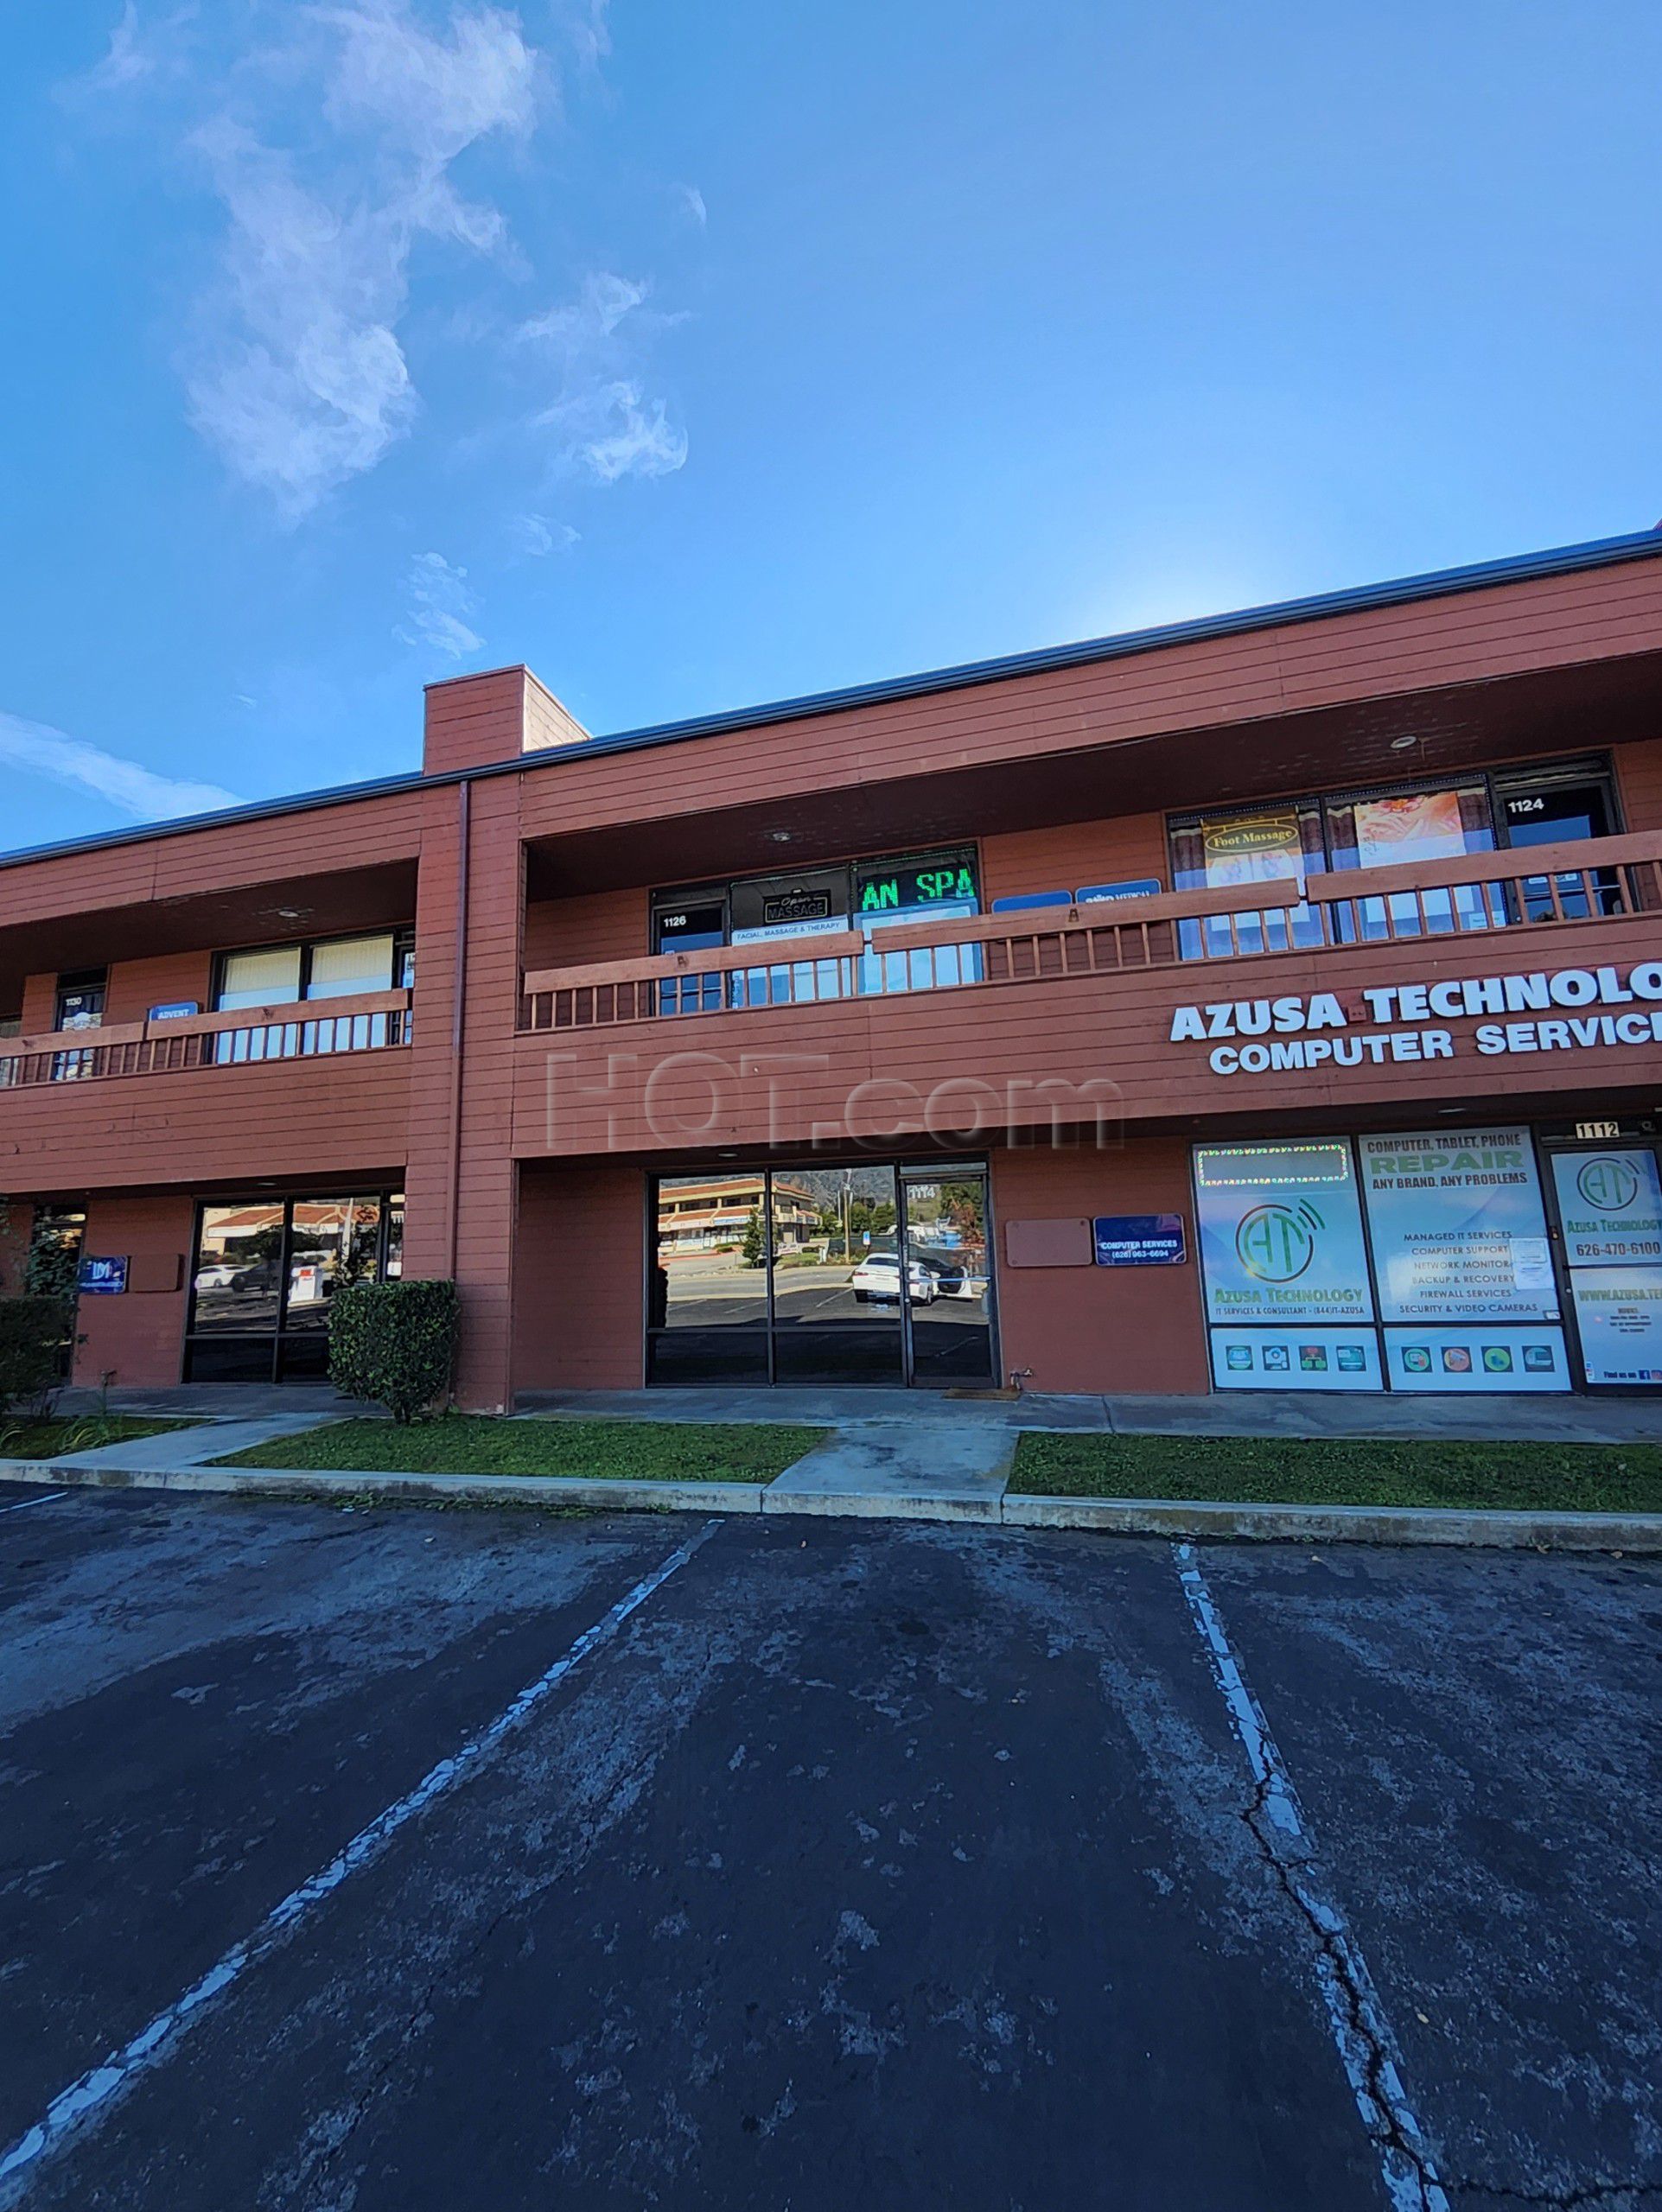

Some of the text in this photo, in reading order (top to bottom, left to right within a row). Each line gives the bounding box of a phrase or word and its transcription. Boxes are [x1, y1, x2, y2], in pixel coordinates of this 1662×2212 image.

[1508, 798, 1544, 813] 1124
[1213, 830, 1293, 847] Foot Massage
[916, 868, 975, 903] SPA
[781, 896, 812, 907] Open
[768, 903, 824, 919] MASSAGE
[664, 916, 686, 927] 1126
[765, 927, 799, 937] MASSAGE
[807, 922, 840, 931] THERAPY
[158, 1008, 189, 1020] ADVENT
[1169, 993, 1347, 1042] AZUSA
[1209, 1029, 1454, 1075] COMPUTER
[1579, 1123, 1616, 1137] 1112
[1367, 1134, 1521, 1154] COMPUTER, TABLET, PHONE
[1370, 1150, 1525, 1174] REPAIR
[1372, 1178, 1394, 1190] ANY
[1441, 1175, 1462, 1186] ANY
[1465, 1172, 1528, 1185] PROBLEMS
[909, 1186, 935, 1198] 1114
[1567, 1219, 1598, 1233] AZUSA
[1404, 1232, 1455, 1242] MANAGED
[1468, 1230, 1512, 1240] SERVICES
[1101, 1240, 1178, 1249] COMPUTER SERVICES
[1411, 1245, 1509, 1255] COMPUTER SUPPORT
[1576, 1242, 1660, 1256] 626-470-6100
[1414, 1261, 1460, 1270] NETWORK
[1412, 1275, 1451, 1285] BACKUP
[1463, 1274, 1515, 1283] RECOVERY
[1214, 1287, 1363, 1304] AZUSA TECHNOLOGY
[1467, 1289, 1512, 1298] SERVICES
[1263, 1306, 1307, 1315] CONSULTANT
[1399, 1305, 1442, 1313] SECURITY
[1455, 1304, 1487, 1313] VIDEO
[1488, 1303, 1538, 1313] CAMERAS
